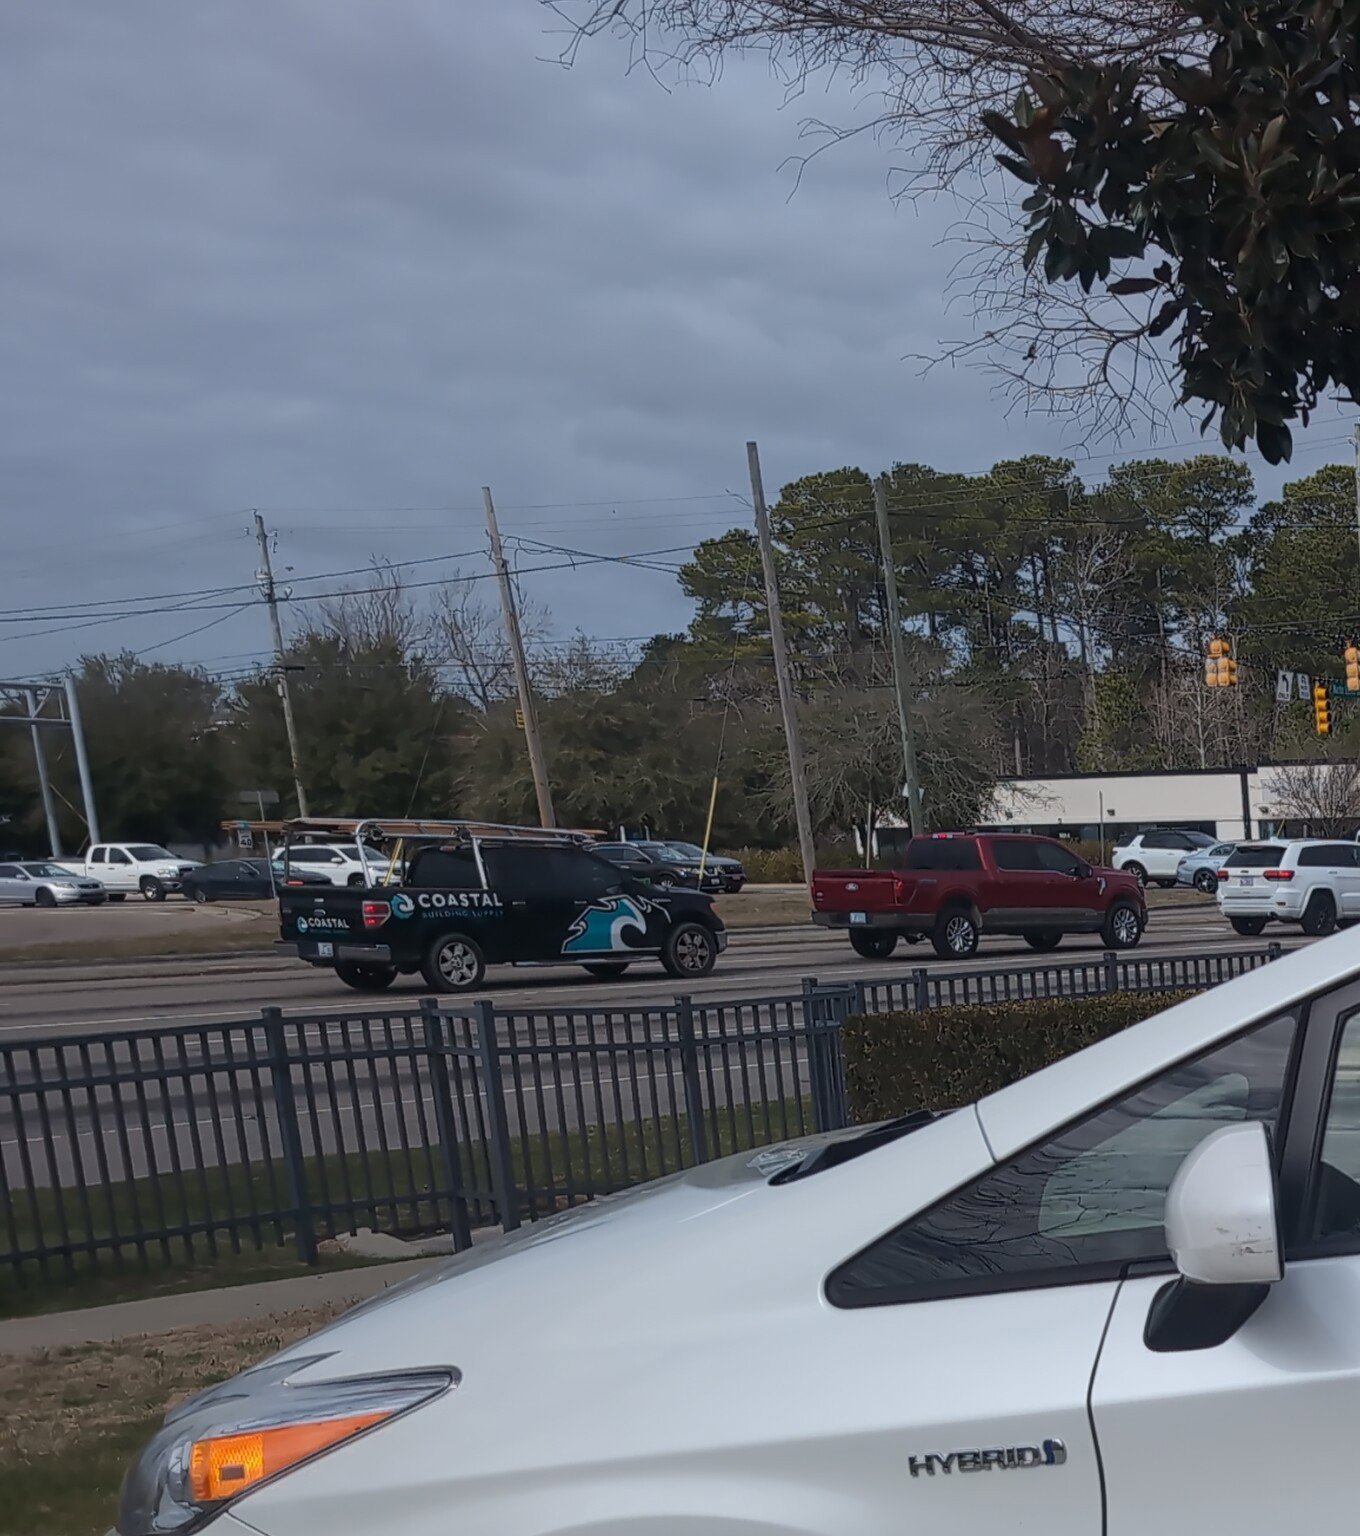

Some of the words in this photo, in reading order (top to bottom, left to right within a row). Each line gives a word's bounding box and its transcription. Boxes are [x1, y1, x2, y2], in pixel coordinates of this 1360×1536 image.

[418, 893, 503, 908] COASTAL
[422, 910, 468, 919] BUILDING
[307, 917, 351, 929] COASTAL
[908, 1445, 1042, 1478] HYBRID
